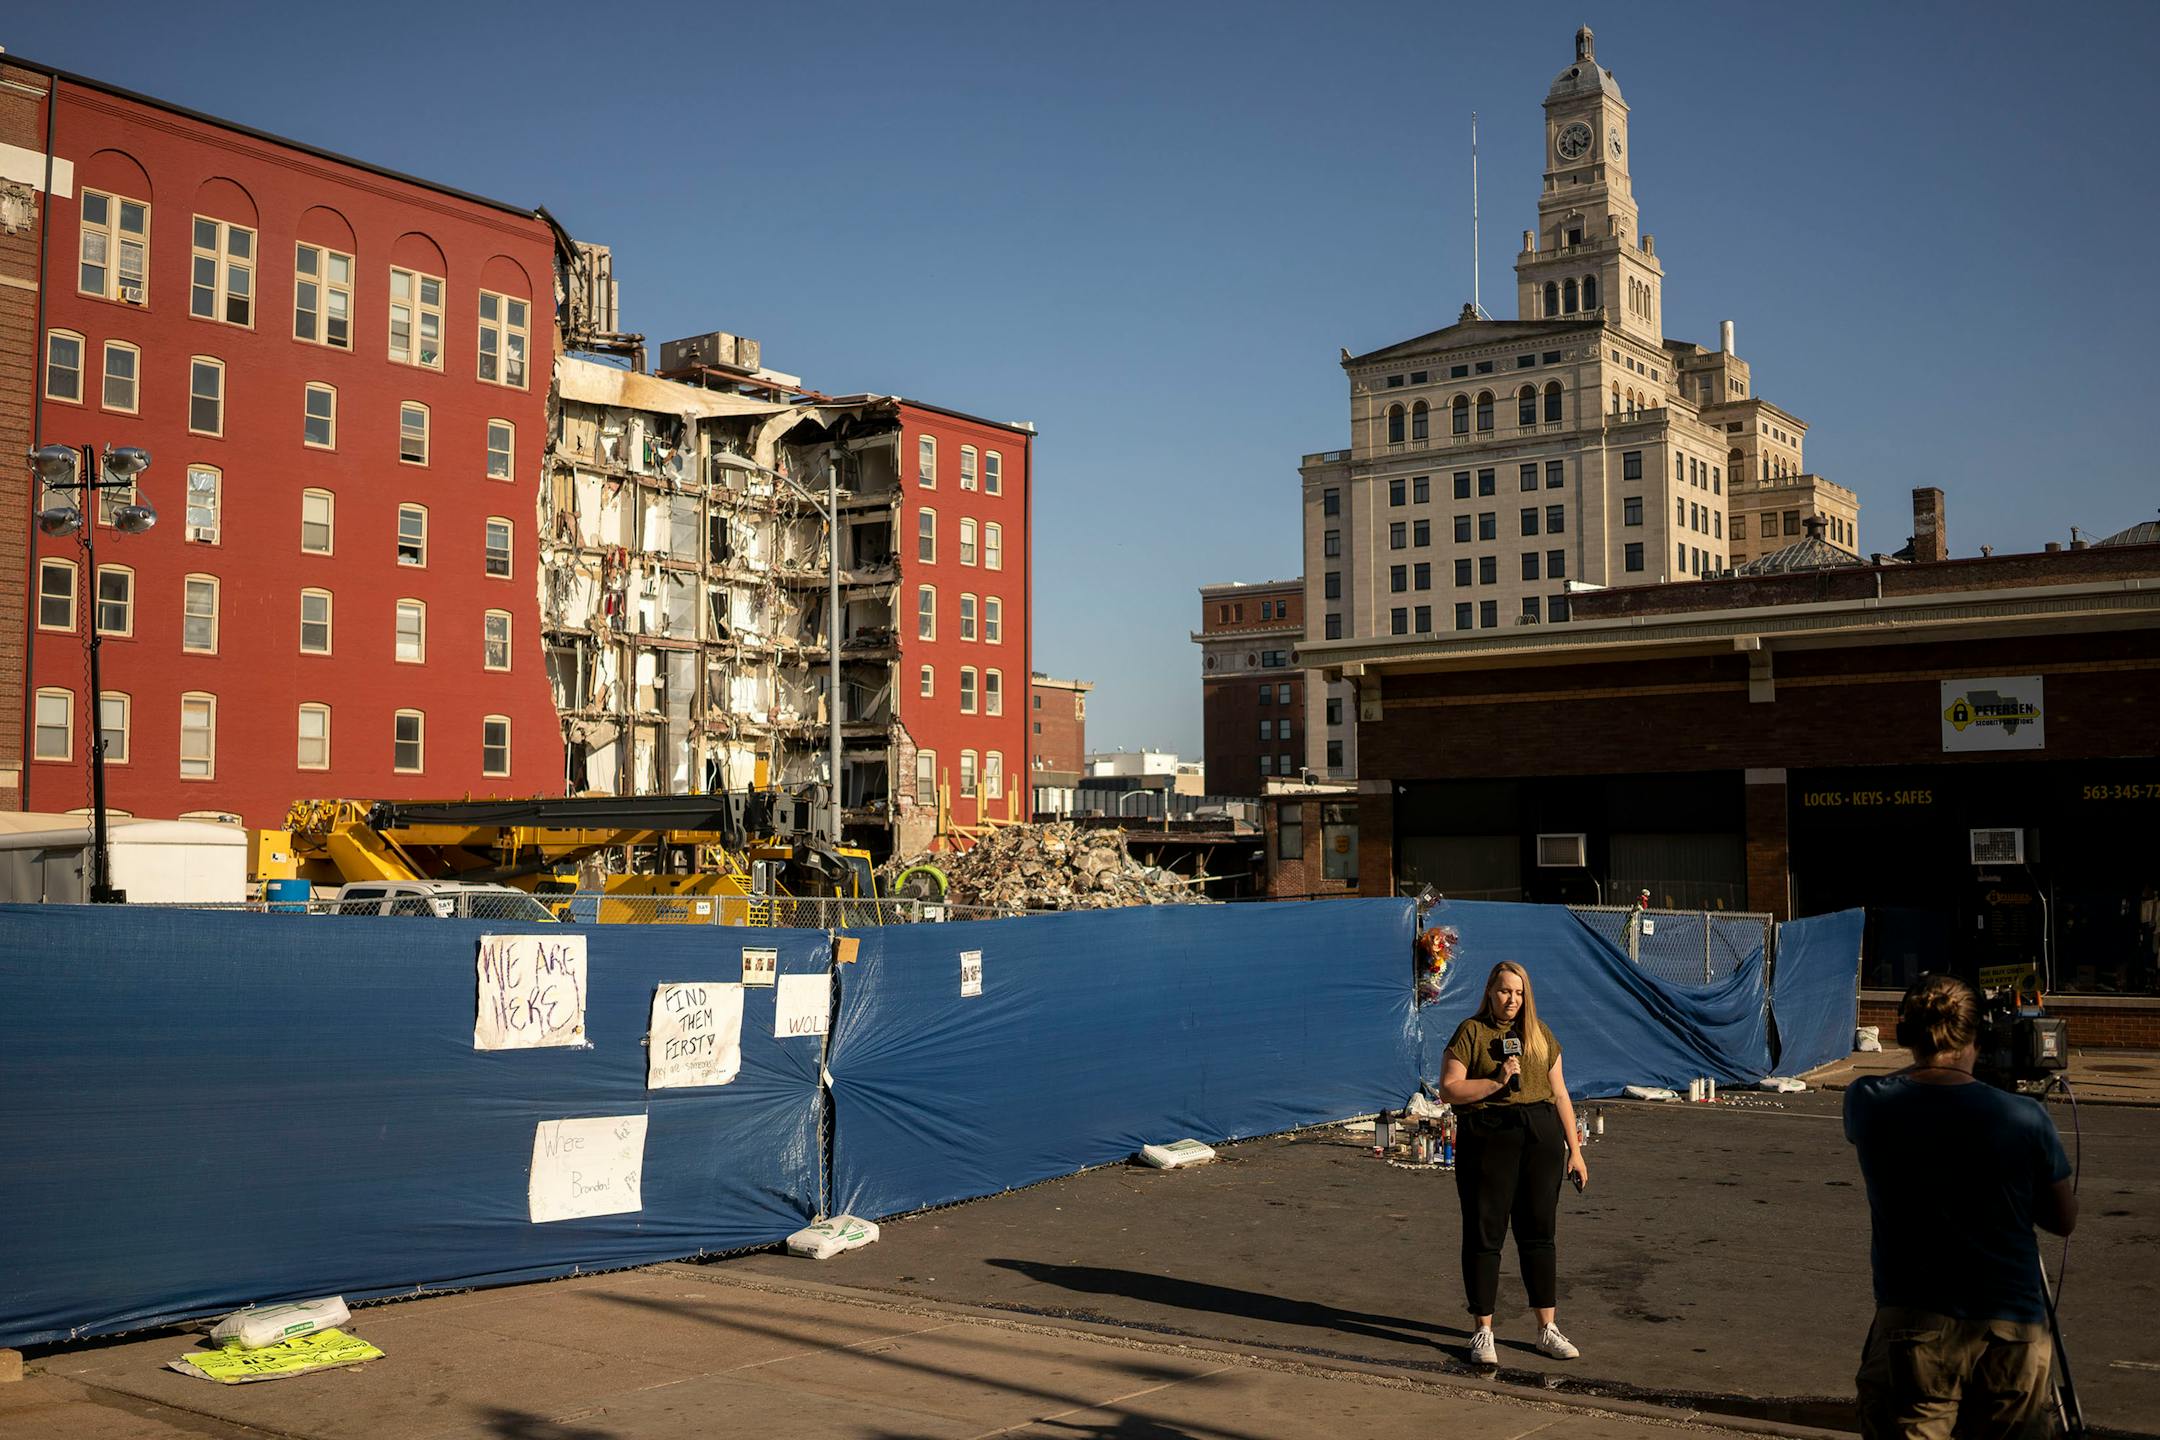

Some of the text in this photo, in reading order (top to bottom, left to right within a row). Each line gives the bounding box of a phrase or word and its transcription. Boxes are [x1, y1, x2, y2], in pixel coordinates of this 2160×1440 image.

[1975, 703, 2033, 716] PETERSEN
[1804, 789, 1933, 807] LOCKS KEYS SAFES
[2083, 783, 2160, 800] 563-345-72
[483, 939, 576, 988] WE ARE
[665, 987, 707, 1012] FIND
[678, 1008, 713, 1032] THEM
[665, 1034, 715, 1060] FIRST!
[542, 1122, 584, 1159] Where
